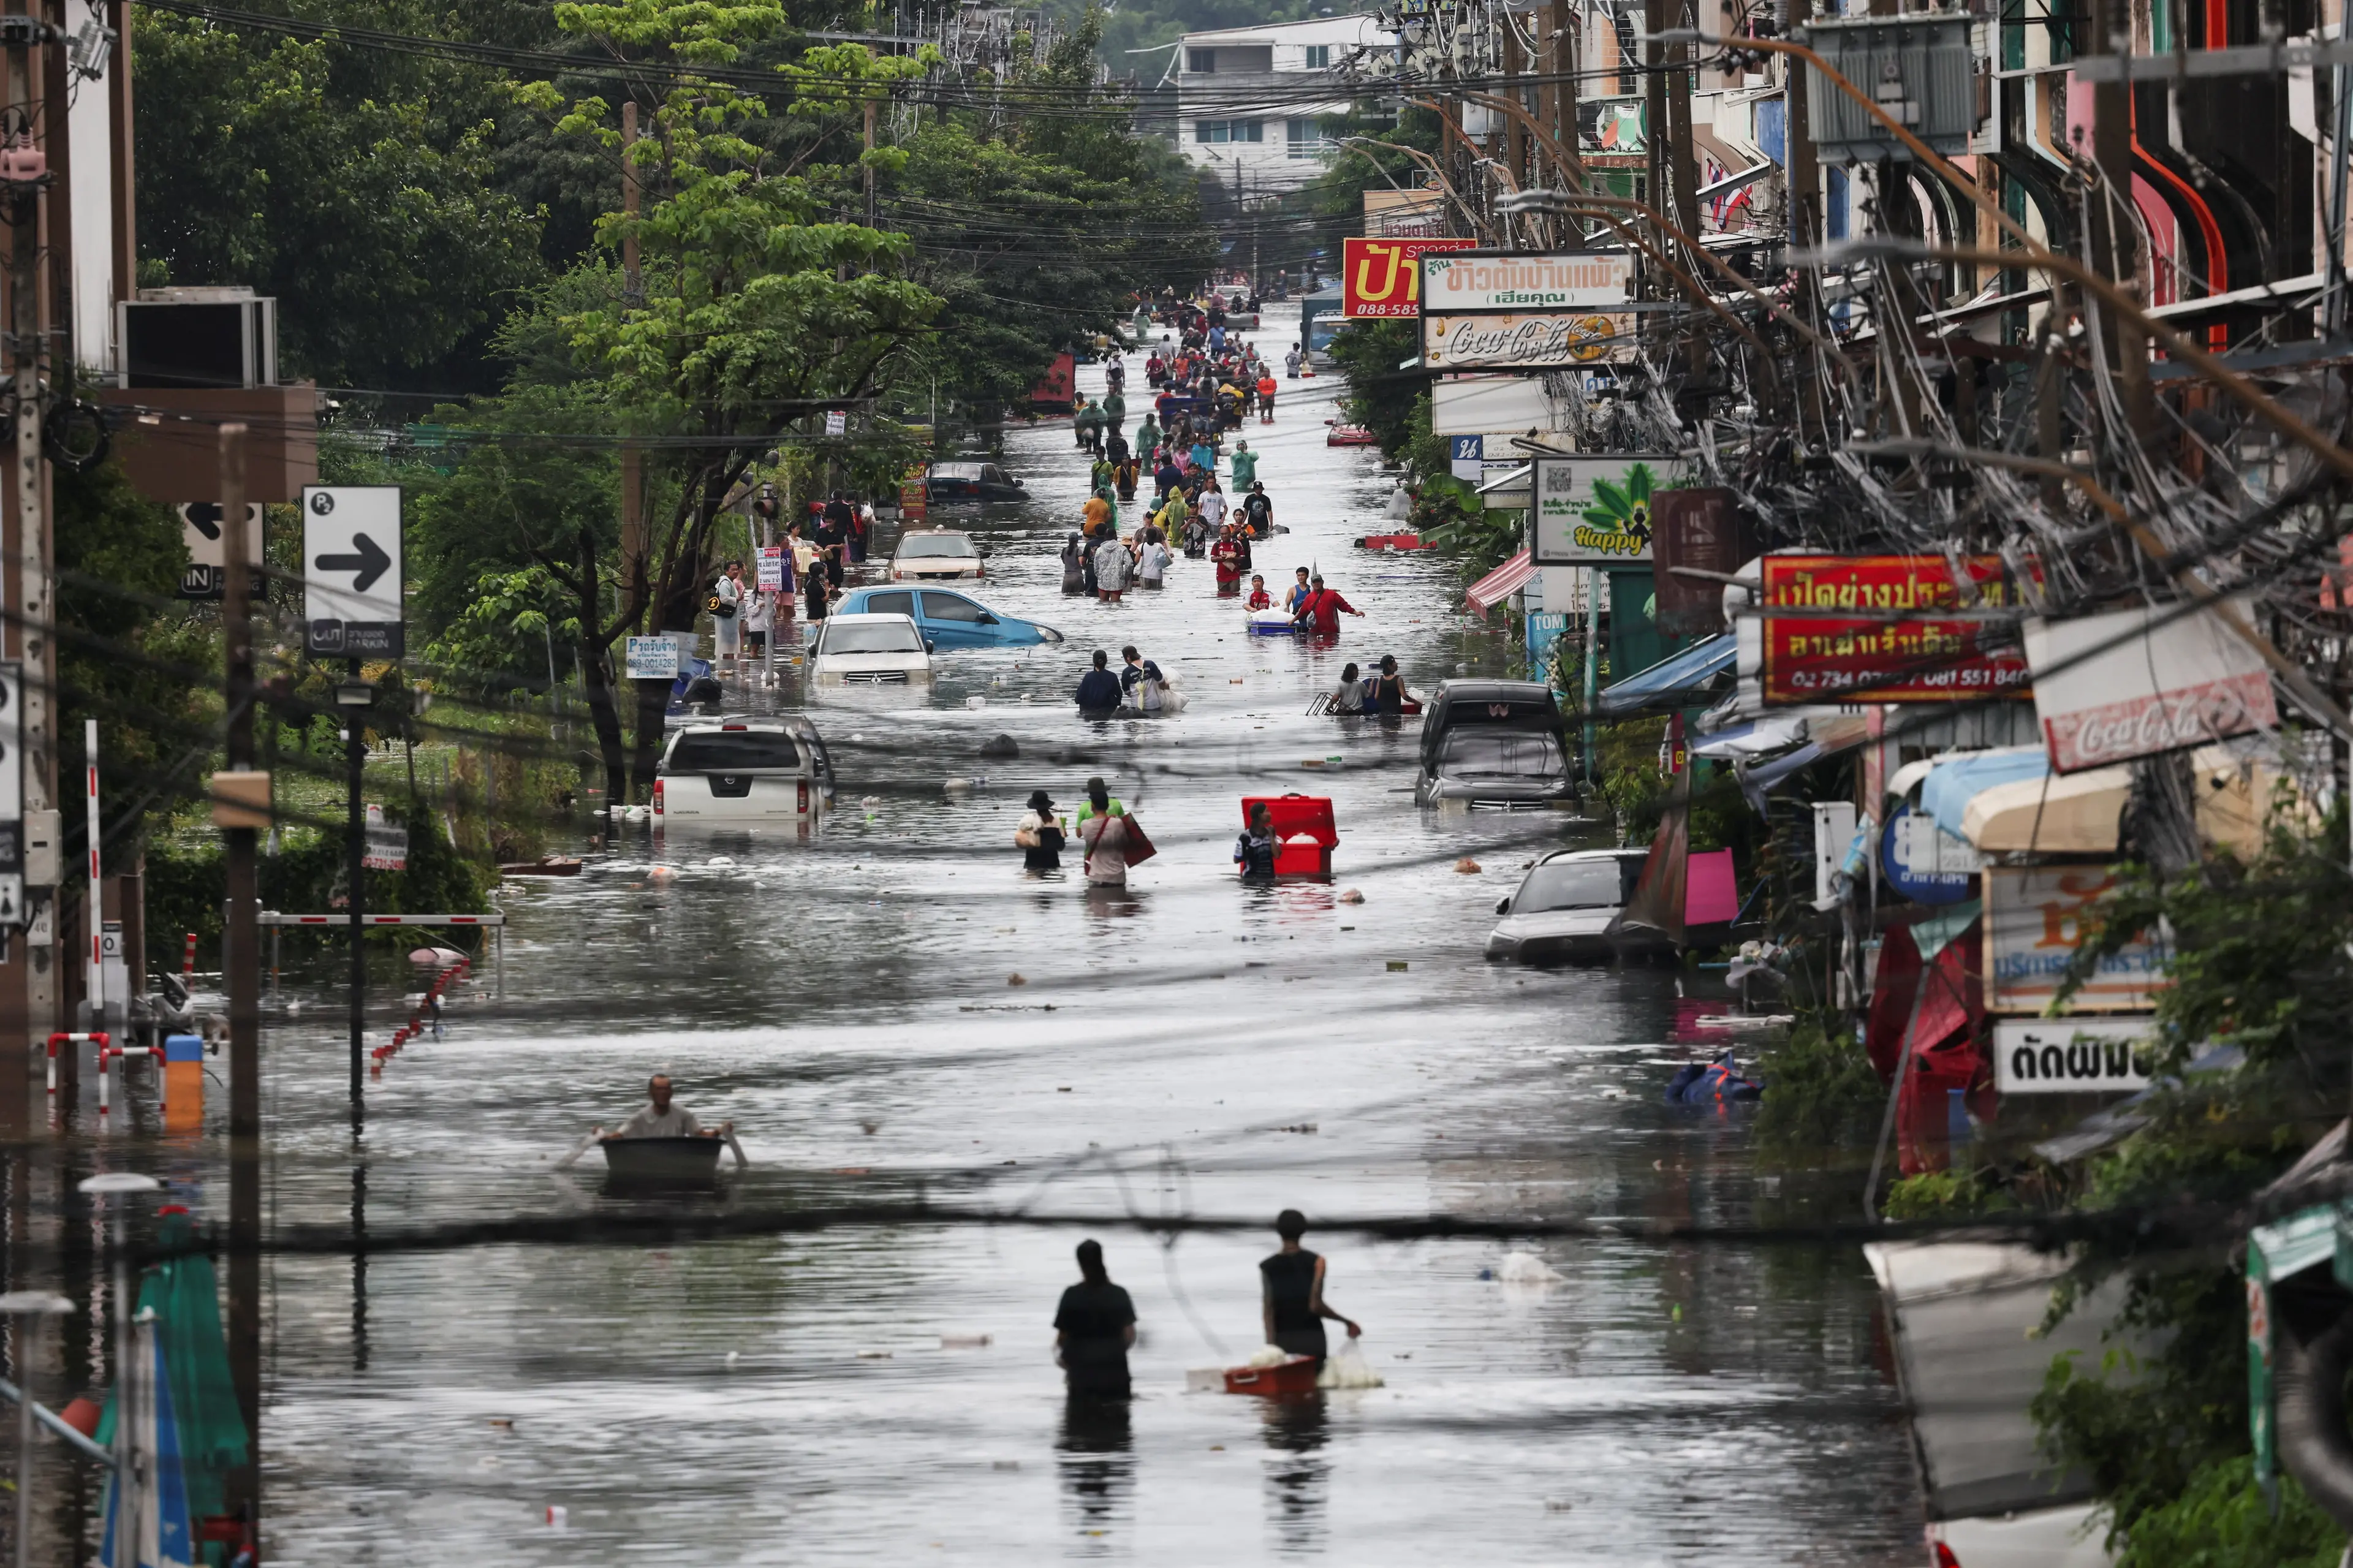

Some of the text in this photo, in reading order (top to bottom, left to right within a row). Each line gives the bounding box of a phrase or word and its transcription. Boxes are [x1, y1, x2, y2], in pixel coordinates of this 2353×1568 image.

[1428, 259, 1452, 276] ร้าน
[1447, 256, 1627, 292] ข้าวต้มบ้านแพ้ว
[1444, 318, 1574, 364] Coca-Cola
[1574, 525, 1643, 556] Happy
[1533, 615, 1564, 631] TOM
[628, 638, 637, 652] P
[1820, 672, 1854, 687] 734
[1962, 670, 1991, 686] 551
